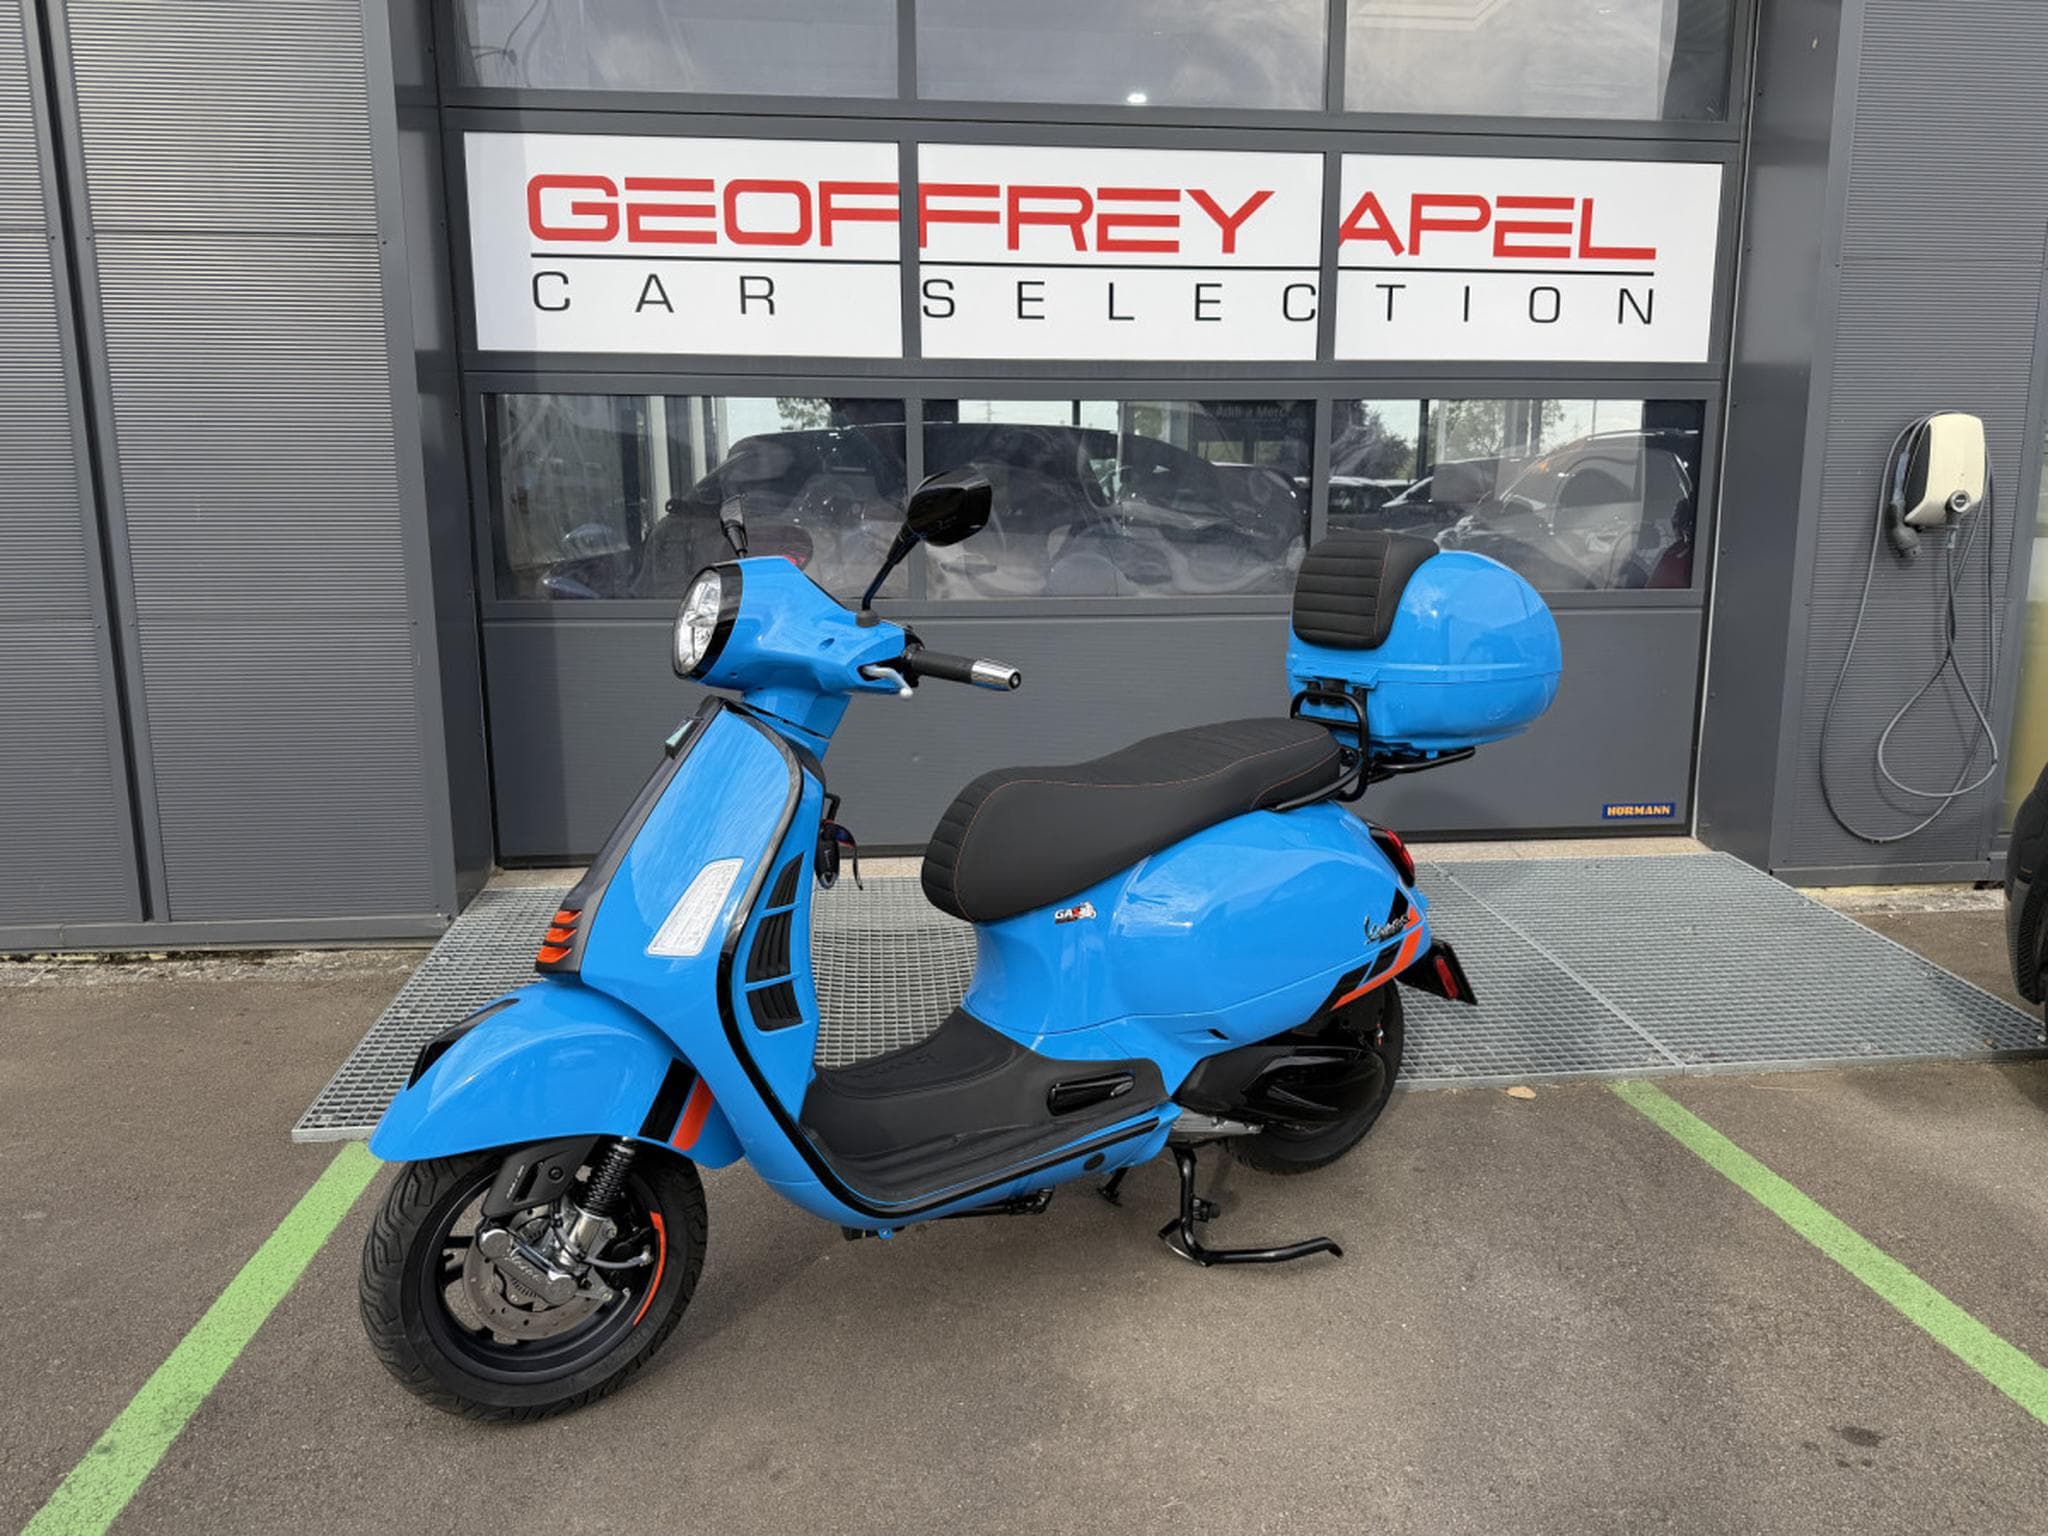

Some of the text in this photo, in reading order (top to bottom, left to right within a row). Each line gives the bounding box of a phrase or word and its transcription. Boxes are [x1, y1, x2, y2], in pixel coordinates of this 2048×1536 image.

[527, 174, 1657, 260] GEOFFREY APEL
[532, 271, 1654, 325] CAR SELECTION
